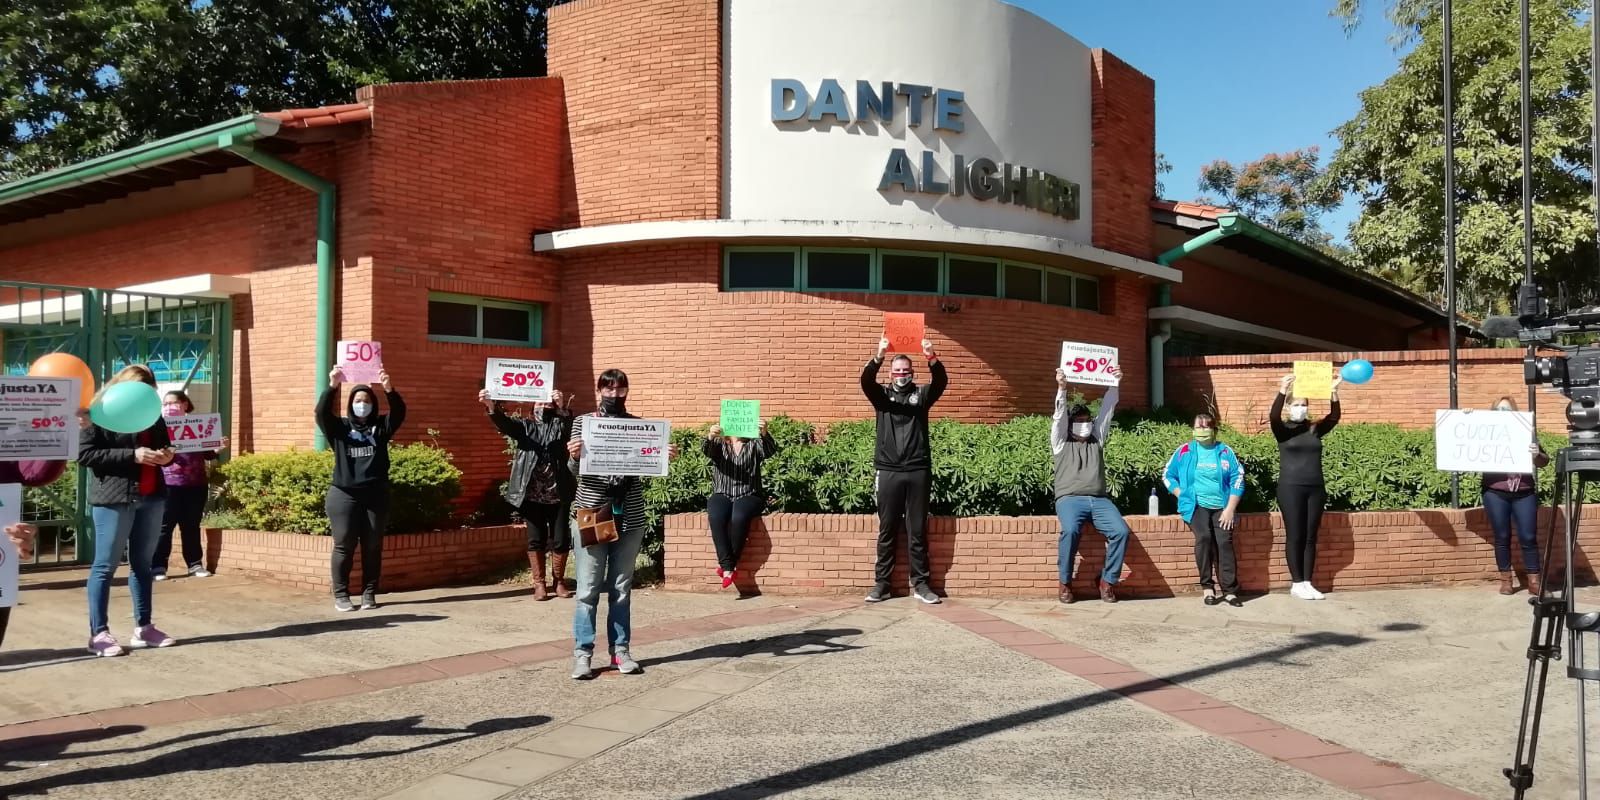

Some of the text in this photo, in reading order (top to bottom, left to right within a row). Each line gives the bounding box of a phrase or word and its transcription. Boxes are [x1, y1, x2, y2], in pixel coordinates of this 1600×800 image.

[770, 78, 965, 134] DANTE
[877, 148, 1081, 221] ALIGHIERI
[1065, 357, 1115, 374] -50%
[501, 371, 545, 387] 50%
[0, 383, 58, 395] justaYA
[31, 415, 66, 430] 50%
[597, 423, 657, 432] #cuotajustaYA
[167, 423, 204, 442] YA!
[1453, 422, 1512, 442] CUOTA
[640, 446, 661, 456] 50%
[1453, 443, 1515, 465] JUSTA
